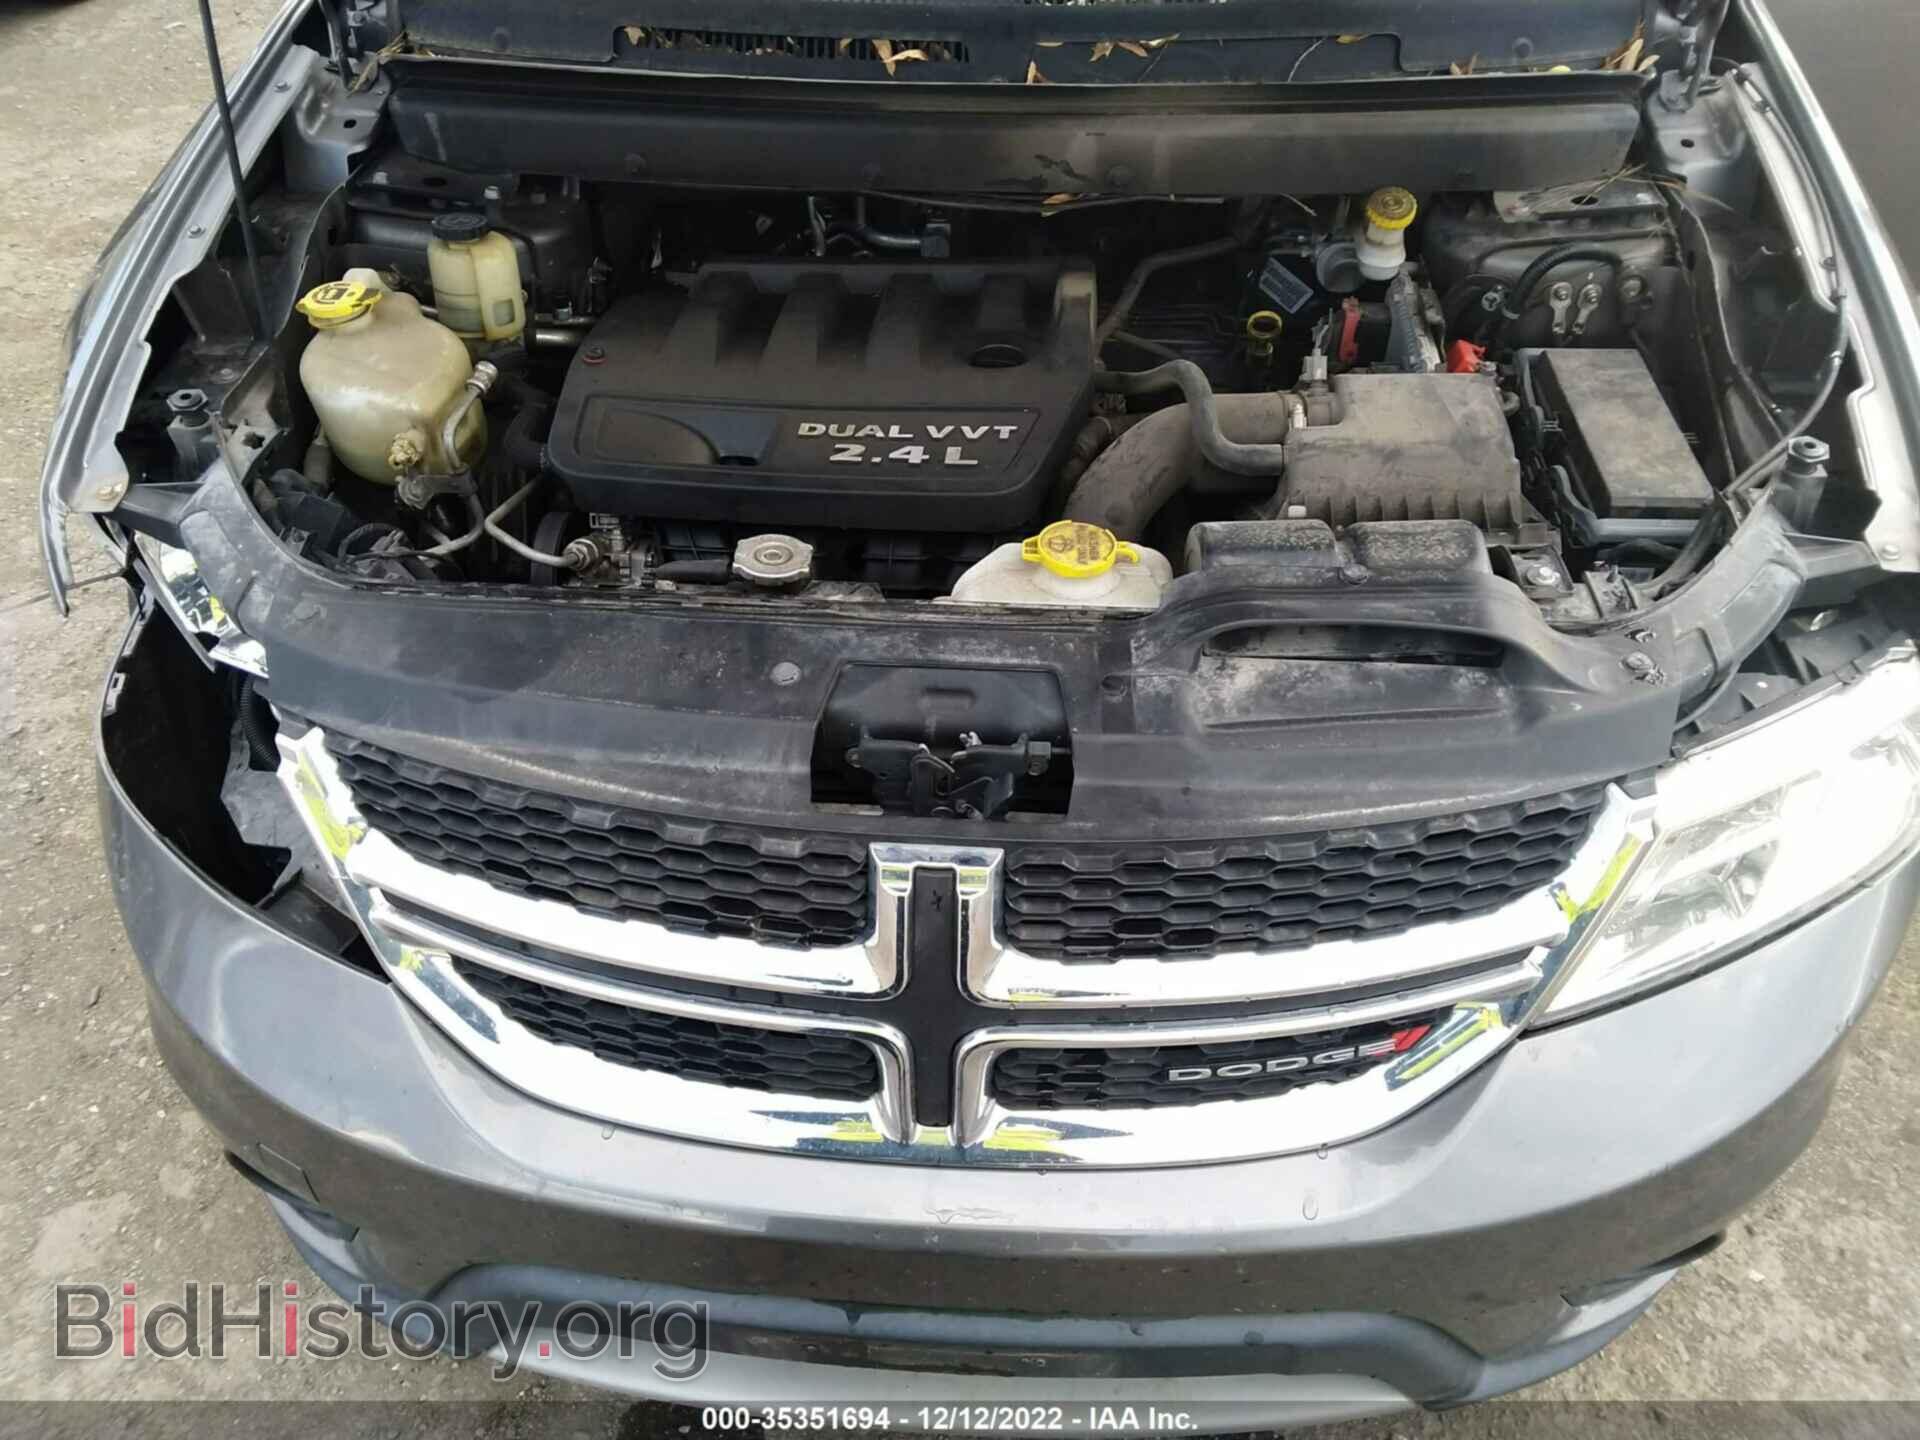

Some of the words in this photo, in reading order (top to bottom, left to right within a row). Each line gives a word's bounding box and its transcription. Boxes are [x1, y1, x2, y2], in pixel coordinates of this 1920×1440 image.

[797, 422, 914, 438] DUAL
[926, 424, 1018, 439] VVT
[1168, 1038, 1397, 1082] DODGE
